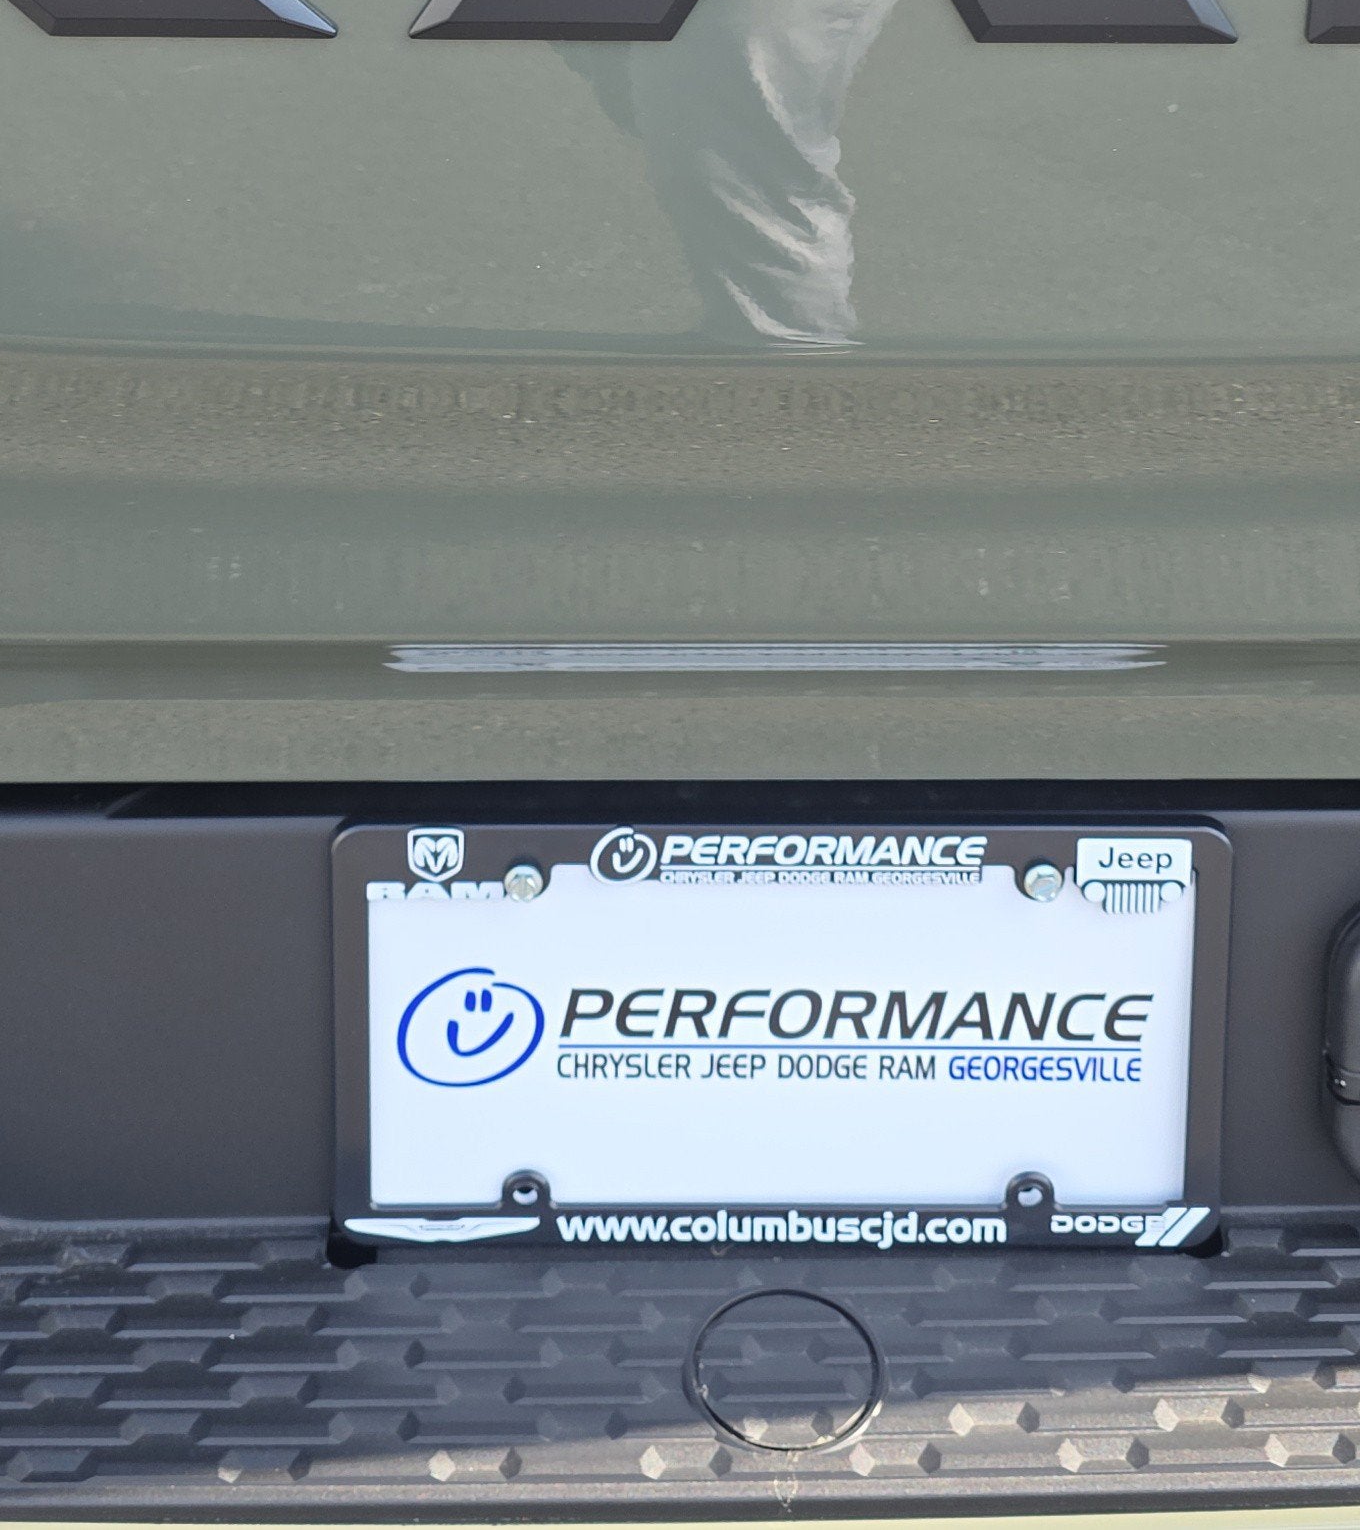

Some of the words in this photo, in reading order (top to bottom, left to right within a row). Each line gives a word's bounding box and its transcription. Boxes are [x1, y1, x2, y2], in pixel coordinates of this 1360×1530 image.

[661, 835, 987, 866] PERFORMANCE
[1098, 847, 1173, 874] Jeep
[366, 881, 505, 901] RAM
[737, 871, 776, 885] JEEP
[778, 871, 833, 885] DODGE
[835, 871, 869, 885] RAM
[872, 871, 982, 885] GEORGESVILLE
[559, 988, 1154, 1042] PERFORMANCE
[557, 1053, 691, 1079] CHRYSLER
[701, 1053, 767, 1079] JEEP
[777, 1054, 868, 1080] DODGE
[878, 1055, 936, 1080] RAM
[948, 1055, 1142, 1082] GEORGESVILLE
[556, 1209, 1007, 1250] www.columbuscjd.com
[1050, 1215, 1167, 1234] DODGE
